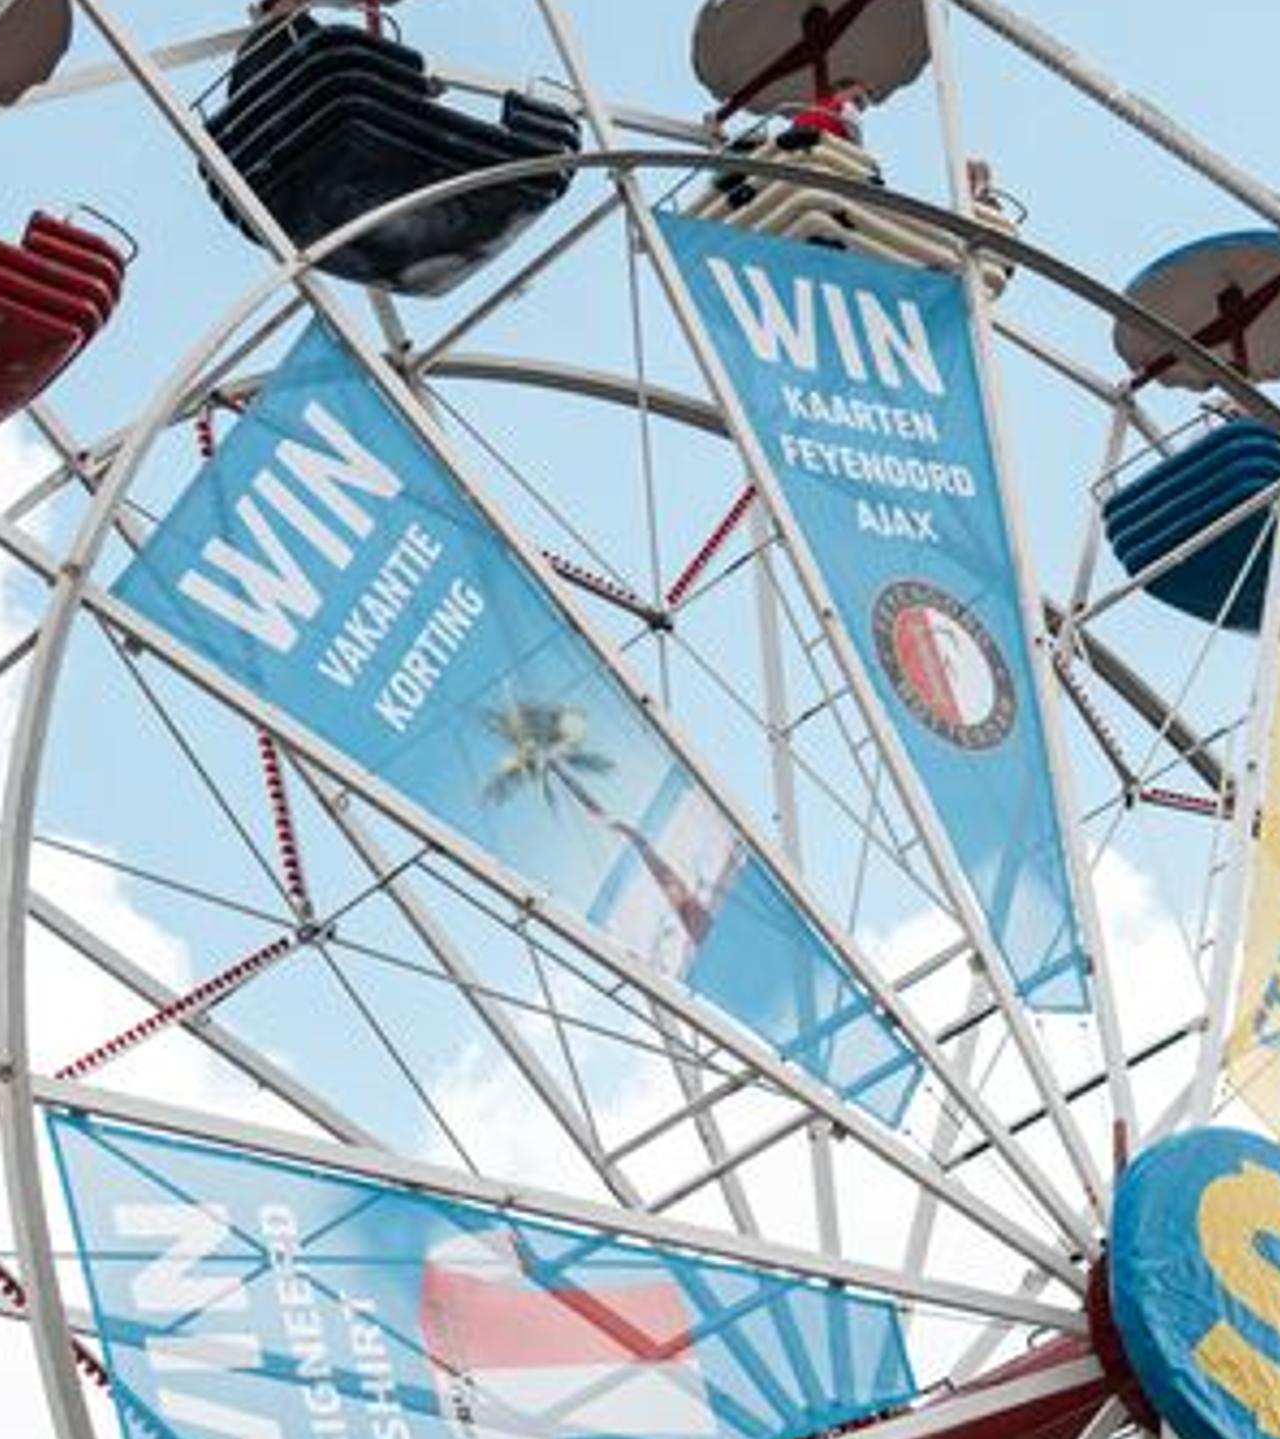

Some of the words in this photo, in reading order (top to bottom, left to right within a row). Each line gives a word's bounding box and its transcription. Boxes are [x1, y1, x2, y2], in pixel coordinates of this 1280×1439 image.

[706, 257, 946, 396] WIN
[780, 434, 976, 497] FEYENOORD
[781, 386, 938, 443] KAARTEN
[177, 399, 404, 654] WIN
[856, 499, 939, 542] AJAX
[318, 522, 443, 688] VAKANTIE
[374, 577, 485, 734] KORTING
